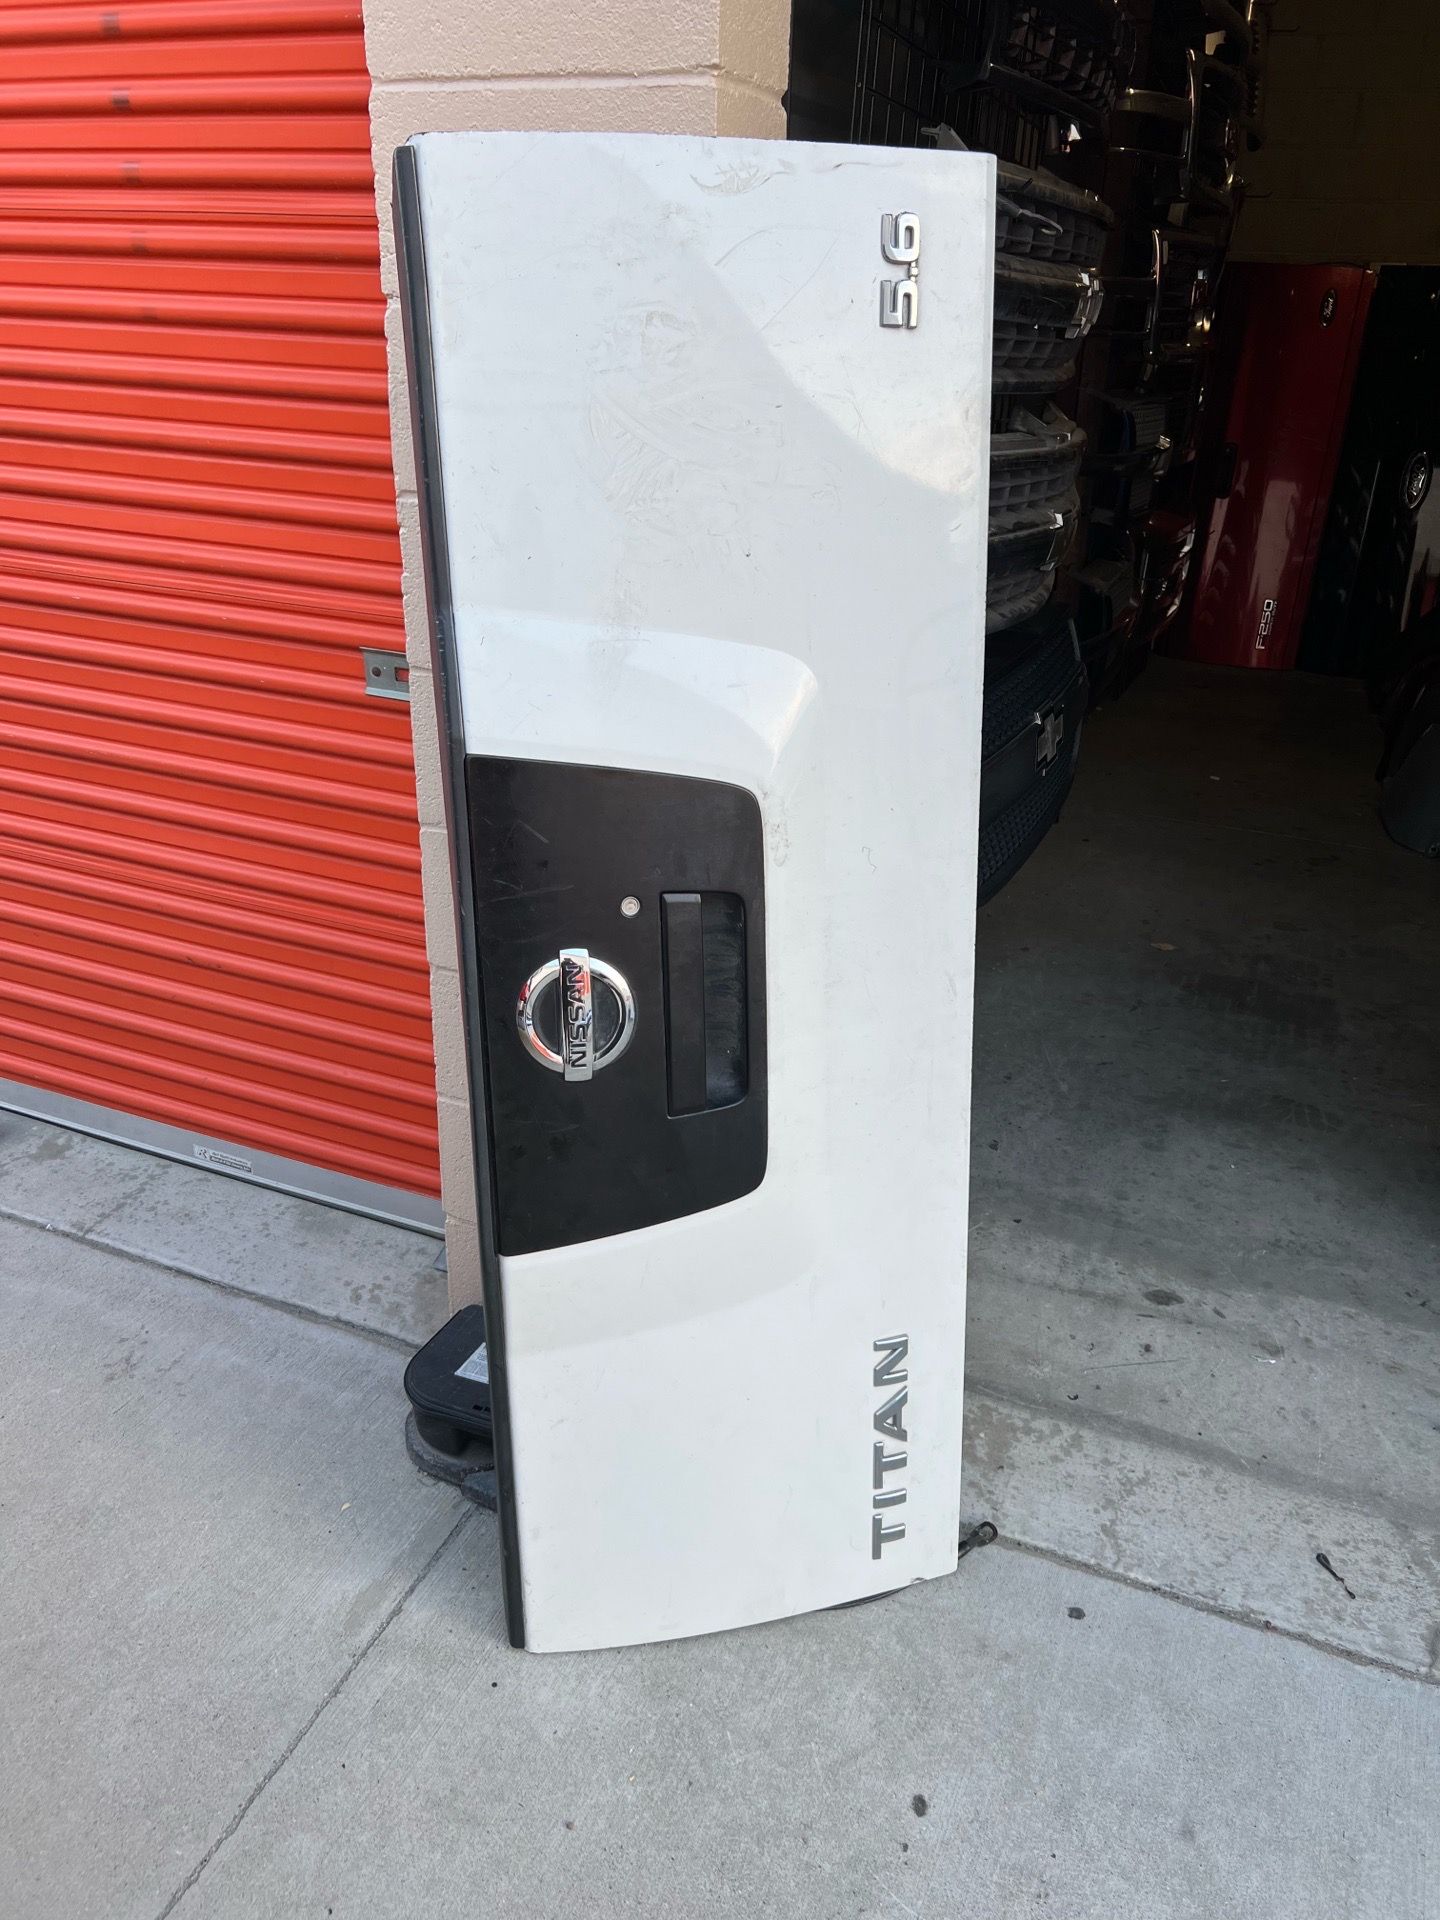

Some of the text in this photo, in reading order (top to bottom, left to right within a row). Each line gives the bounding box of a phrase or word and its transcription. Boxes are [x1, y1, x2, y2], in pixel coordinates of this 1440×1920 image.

[879, 211, 920, 329] 5.6
[564, 959, 589, 1069] NISSAN
[871, 1333, 909, 1560] TITAN
